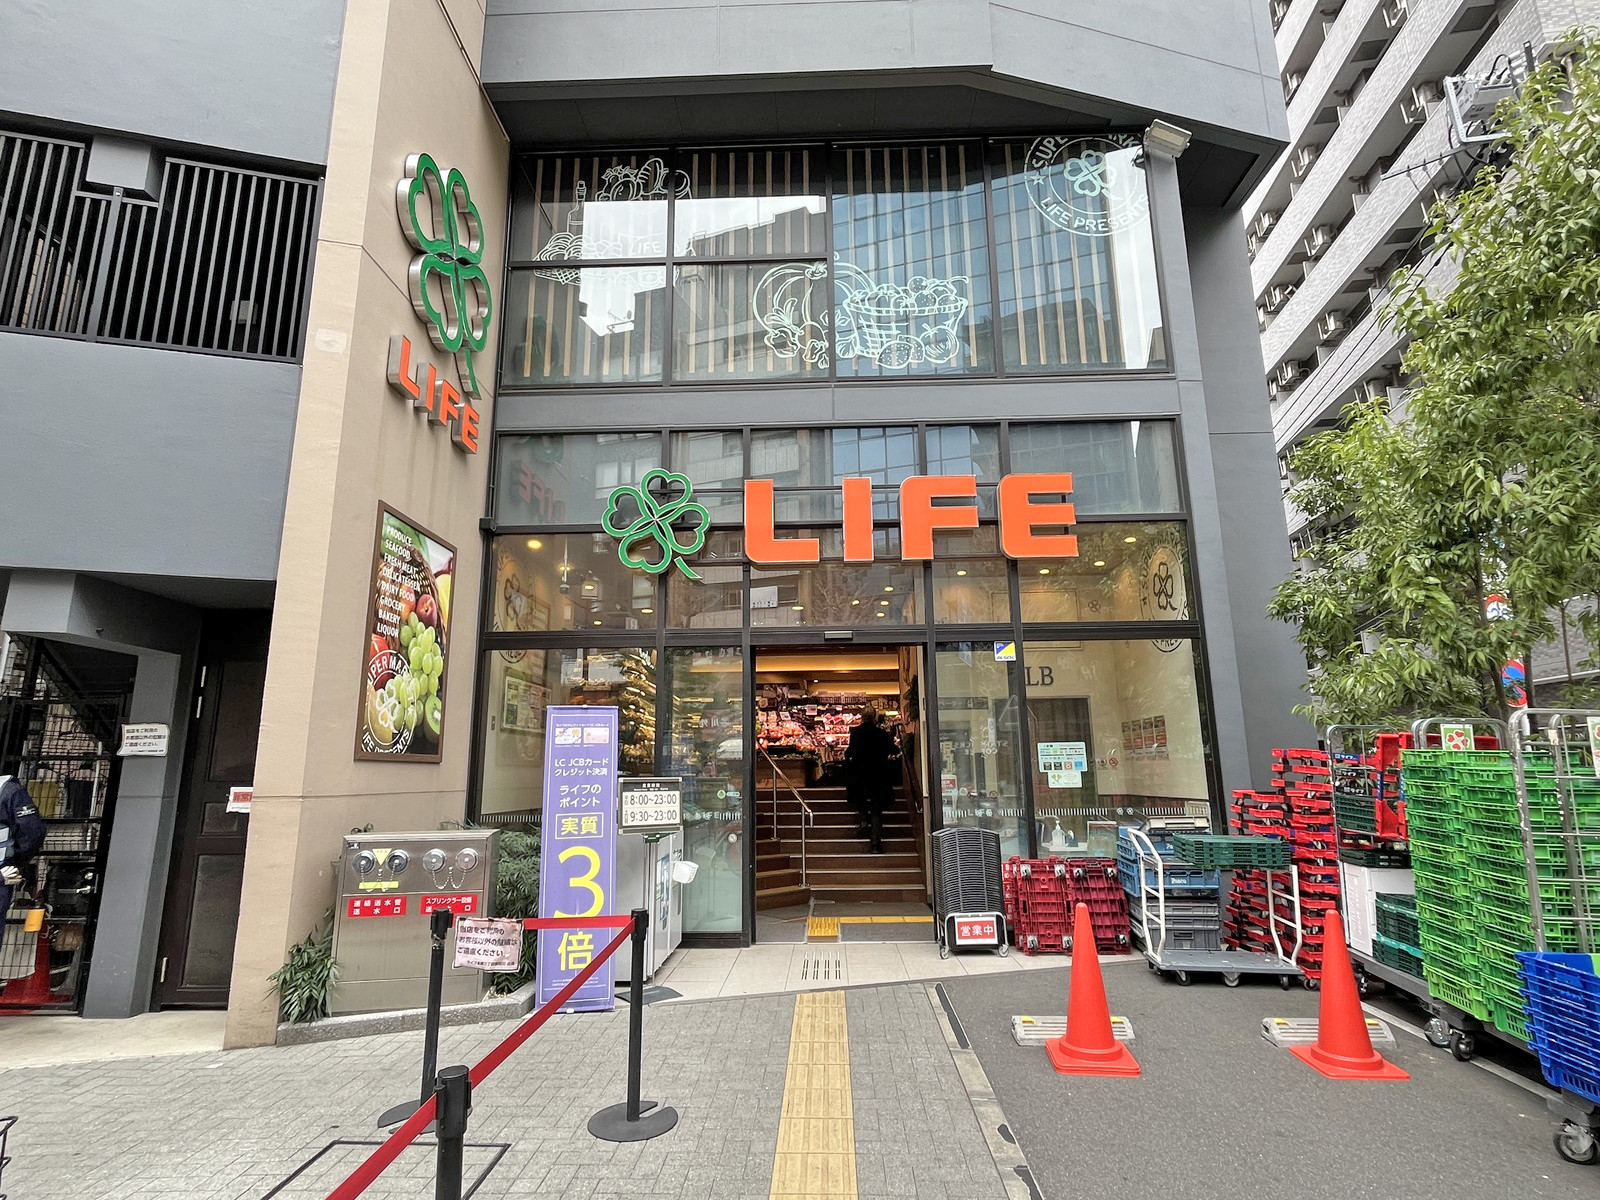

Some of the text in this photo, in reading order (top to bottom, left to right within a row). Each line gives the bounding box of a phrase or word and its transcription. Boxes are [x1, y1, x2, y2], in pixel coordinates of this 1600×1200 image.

[1031, 136, 1069, 169] SUPE
[1040, 194, 1149, 231] LIFE PRESENTS
[398, 334, 480, 454] LIFE
[744, 473, 1079, 562] LIFE
[386, 525, 413, 547] PRODUCE
[383, 552, 419, 576] FRESH MEAT
[382, 567, 421, 592] DELICATESSEN
[381, 581, 415, 602] DAIRY FOOD
[380, 595, 406, 612] GROCERY
[378, 608, 401, 625] BAKERY
[377, 622, 399, 638] LIQUOR
[554, 757, 609, 767] LC JCBカード
[554, 767, 608, 777] クレジット決済
[559, 784, 602, 796] ライフの
[559, 796, 601, 808] ポイント
[560, 816, 599, 835] 実質
[553, 845, 605, 918] 3
[425, 904, 472, 913] 送口
[960, 924, 994, 937] 営業中
[557, 930, 595, 971] 倍
